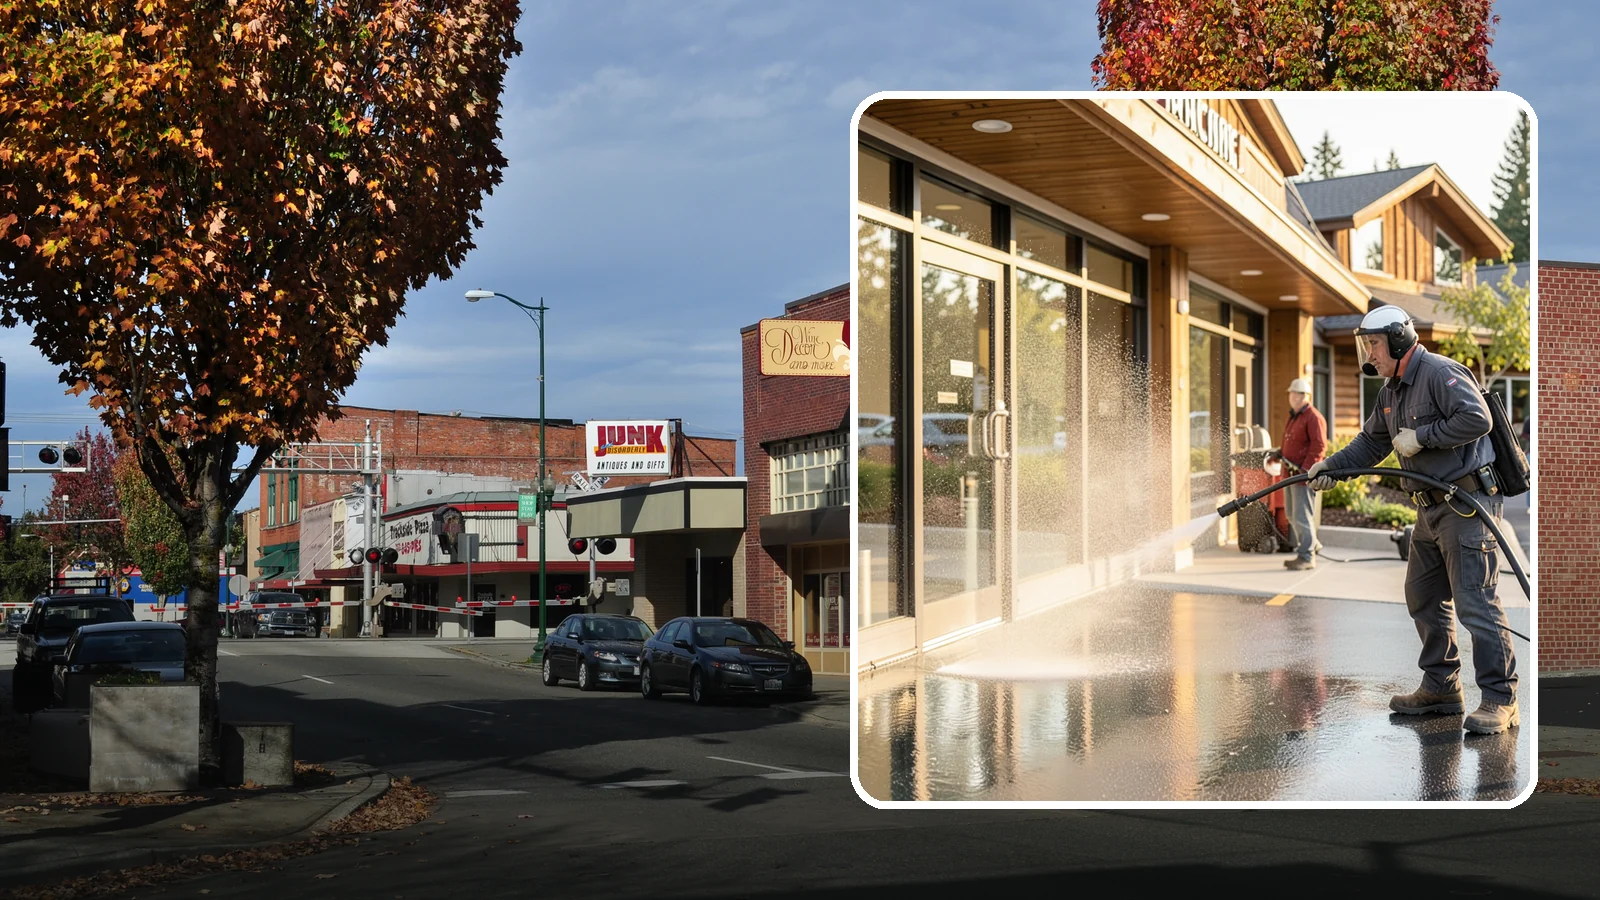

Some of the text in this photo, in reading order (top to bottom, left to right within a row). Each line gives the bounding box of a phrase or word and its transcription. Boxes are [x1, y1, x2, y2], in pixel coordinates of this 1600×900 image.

[595, 425, 665, 457] JUNK
[607, 446, 646, 454] DISORDERLY
[597, 460, 665, 470] ANTIQUES AND GIFTS
[573, 473, 589, 492] RAIL
[390, 519, 429, 540] Trackside Pizza
